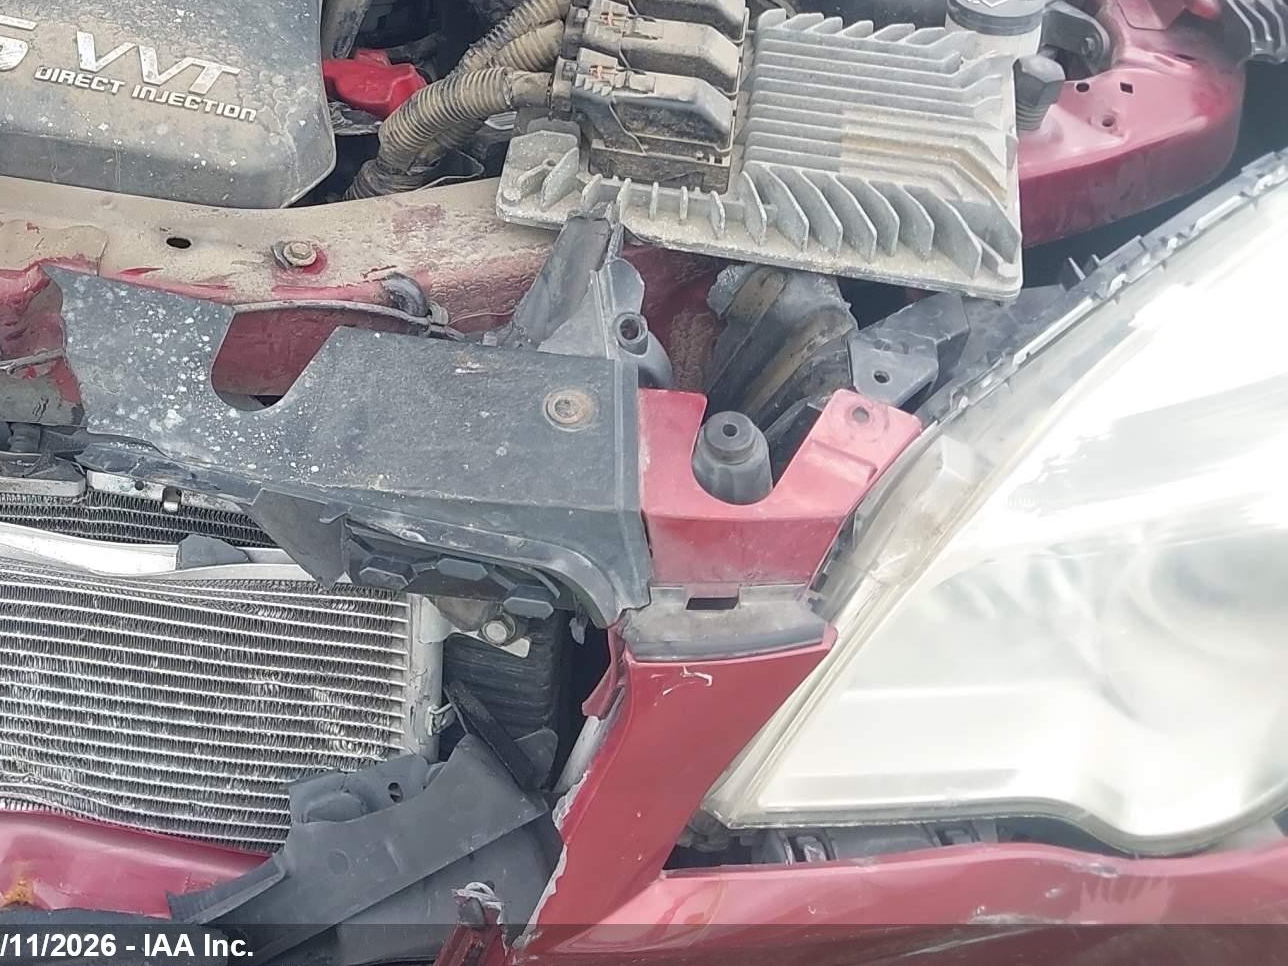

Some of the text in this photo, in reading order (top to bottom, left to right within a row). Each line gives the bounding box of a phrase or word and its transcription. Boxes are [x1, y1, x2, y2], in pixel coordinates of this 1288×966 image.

[76, 31, 241, 95] VVT
[34, 66, 257, 122] DIRECT INJECTION
